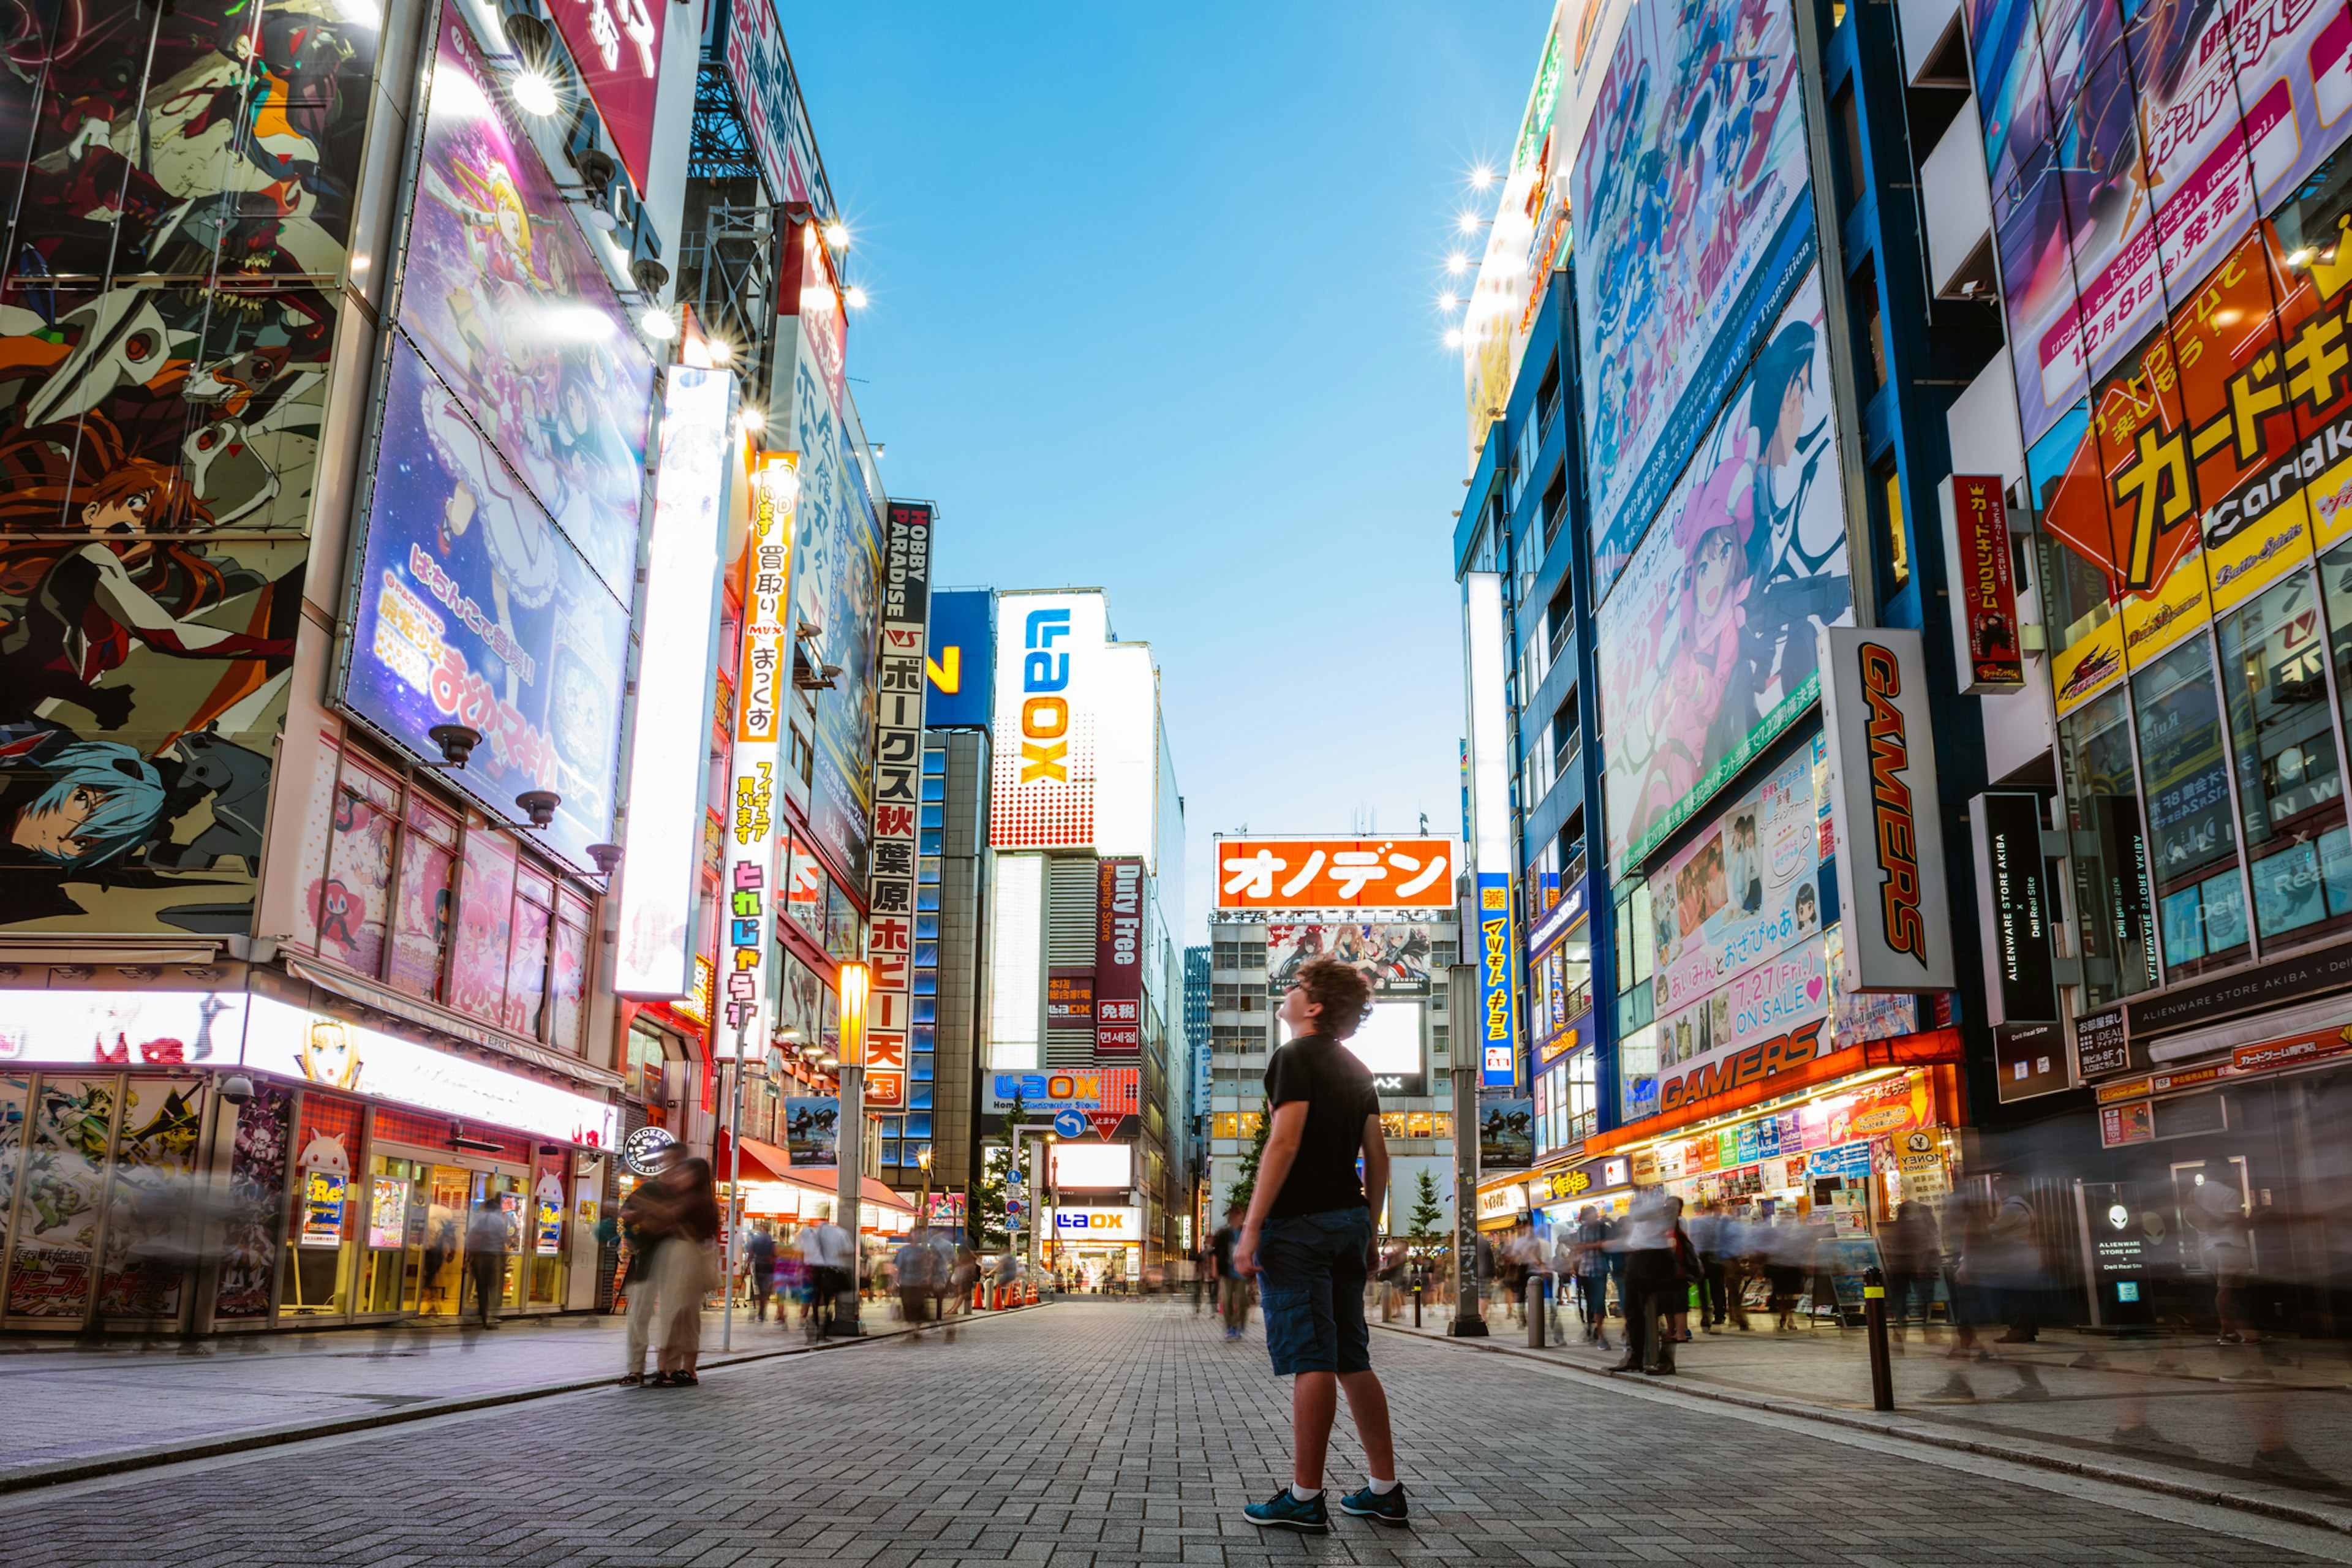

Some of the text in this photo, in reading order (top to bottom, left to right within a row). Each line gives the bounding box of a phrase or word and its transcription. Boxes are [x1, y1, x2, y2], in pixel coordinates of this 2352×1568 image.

[1760, 232, 1809, 327] Transition
[886, 508, 909, 617] PARADISE
[909, 510, 928, 582] HOBBY
[1602, 497, 1686, 642] ガンゲイル・オンライン
[1969, 496, 1999, 609] カードキングダム
[2212, 522, 2304, 592] Battle Spirits
[756, 545, 785, 614] 買取り
[748, 647, 776, 731] まっくす
[734, 777, 756, 845] 買います
[752, 761, 773, 842] フィギュア
[1759, 794, 1811, 832] トレーディングカード
[1858, 641, 1928, 971] GAMERS
[1223, 841, 1447, 900] オノデン
[1483, 889, 1507, 909] 薬
[1100, 865, 1114, 942] Flagship Store
[1112, 864, 1141, 965] Duty Free
[1996, 833, 2018, 981] ALIENWARE STORE AKIBA
[2026, 876, 2040, 938] Dell Real Site
[2195, 889, 2245, 922] Dell
[1048, 989, 1091, 1000] 総合家電
[1049, 979, 1071, 989] 本店
[1735, 950, 1814, 1008] 7.27(Fri.)
[2143, 996, 2211, 1022] ALIENWARE
[2216, 982, 2259, 1002] STORE
[2264, 970, 2308, 989] AKIBA
[1099, 1031, 1136, 1044] 면세점
[1101, 1003, 1136, 1019] 免税
[1736, 985, 1804, 1035] ON SALE
[2010, 1025, 2048, 1041] Dell Real Site
[2078, 1013, 2123, 1034] お部屋探し
[1660, 1016, 1827, 1112] GAMERS
[2102, 1049, 2114, 1061] 8F
[2240, 1041, 2317, 1066] カードゲーム専門店
[1075, 1101, 1100, 1109] Store
